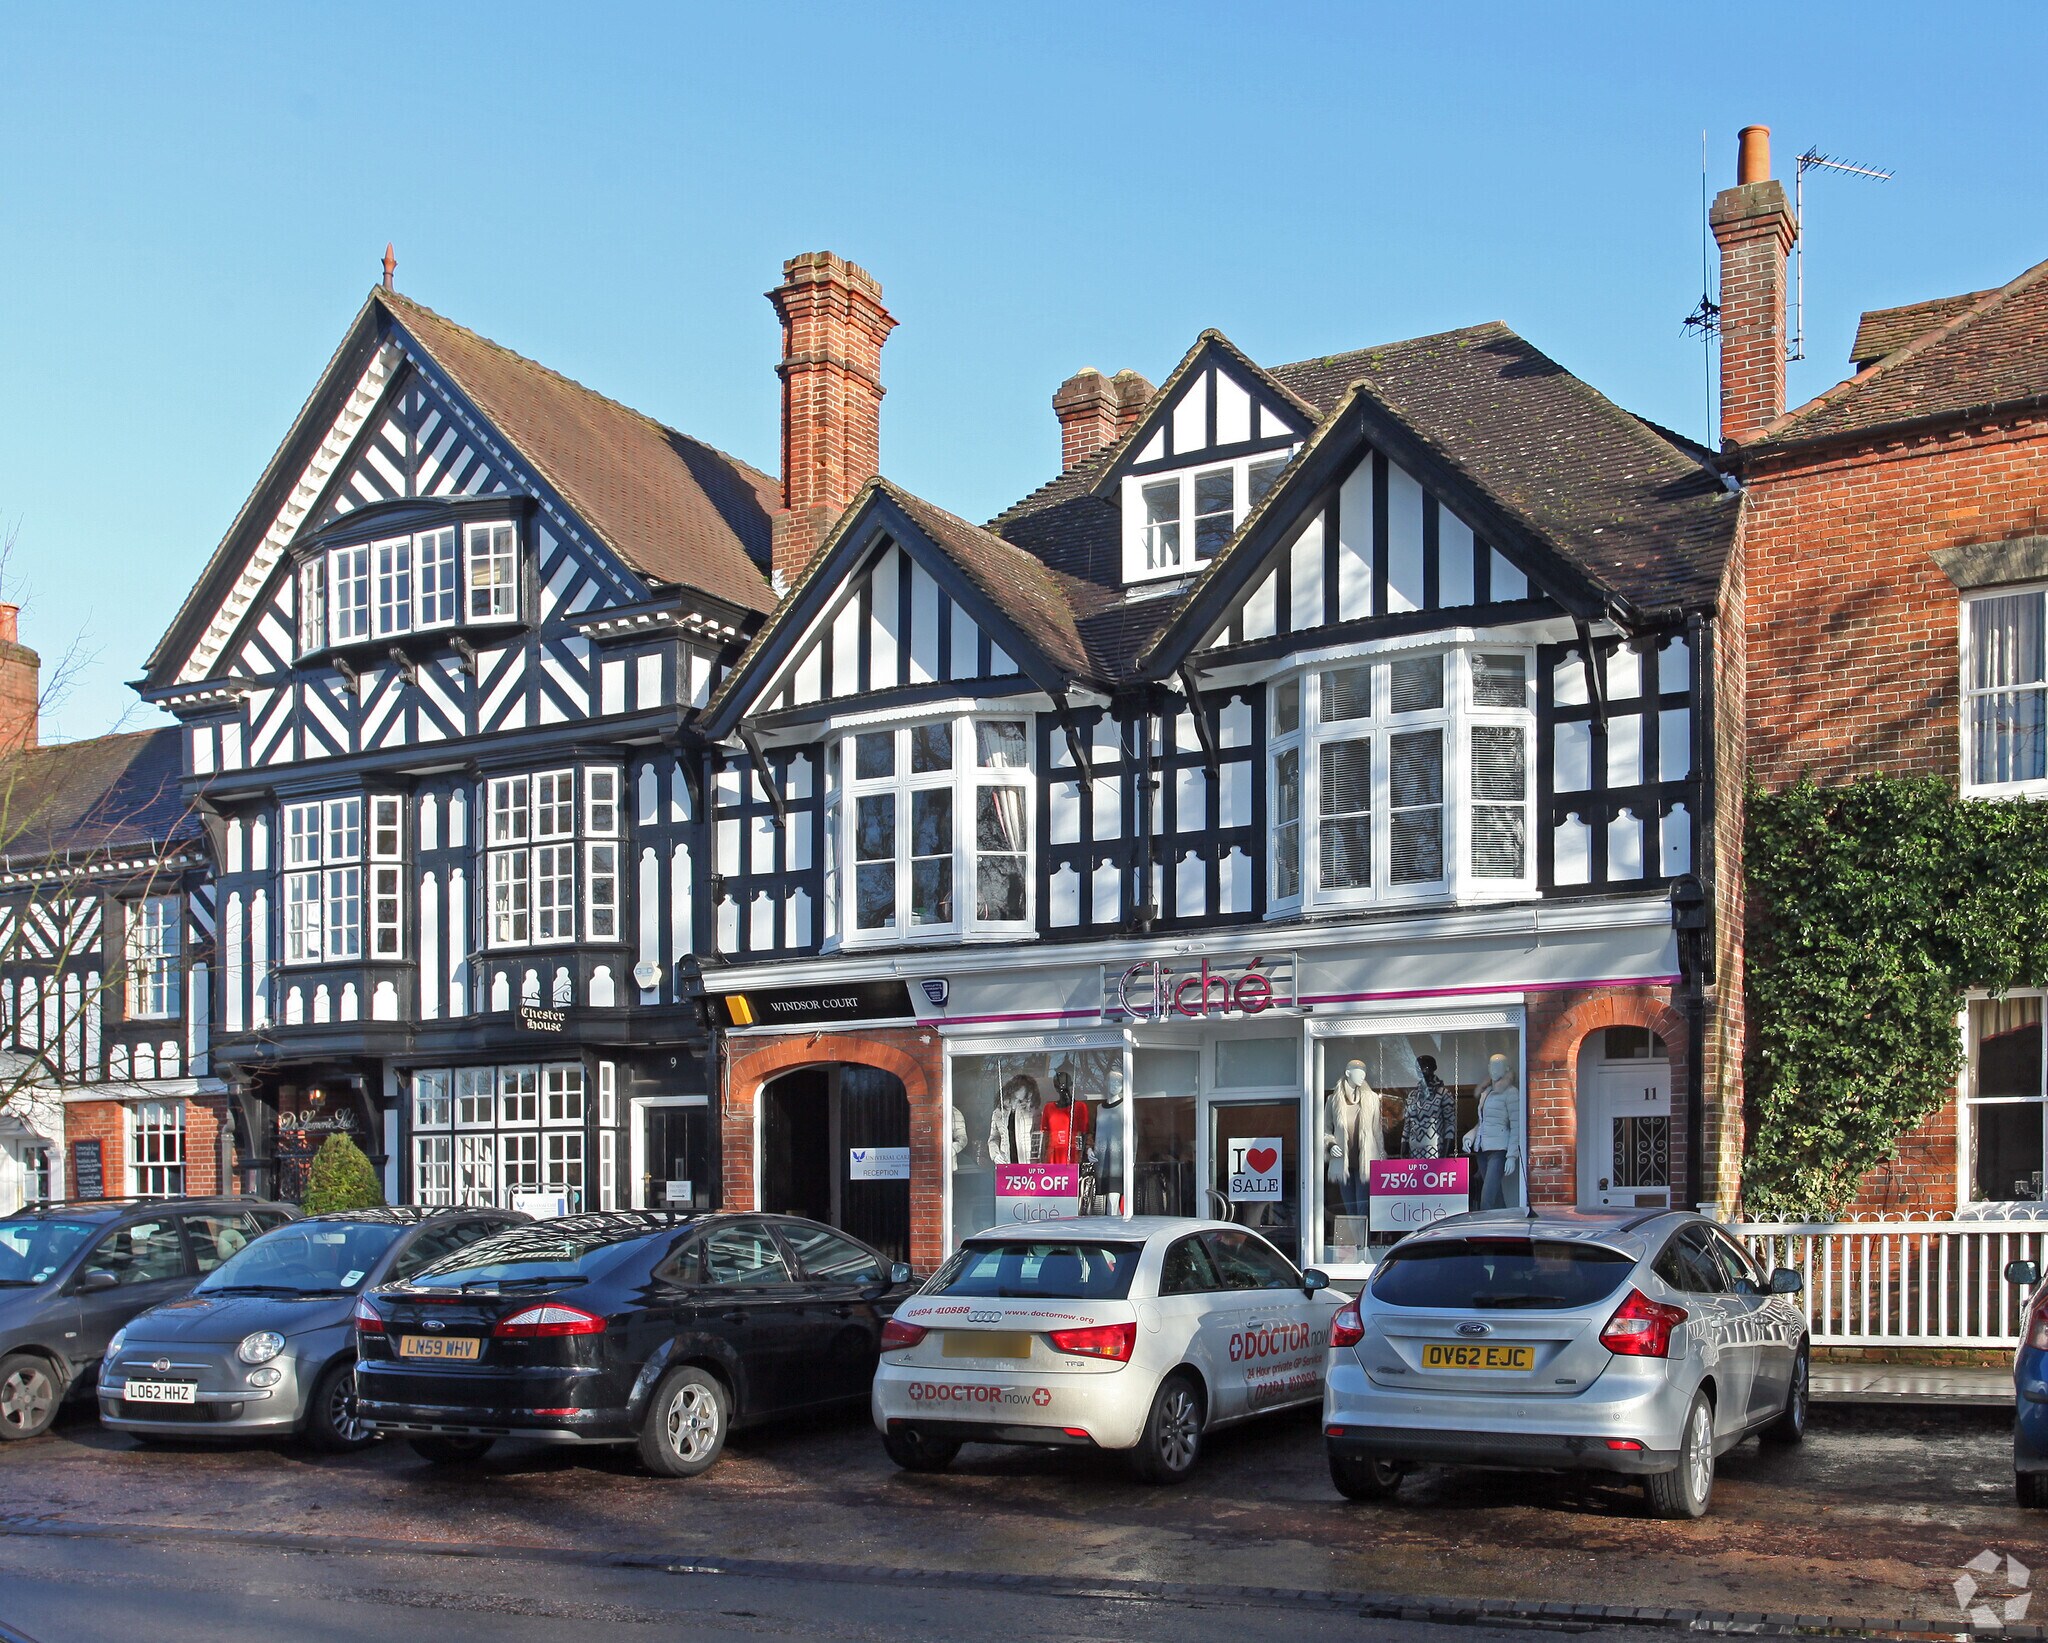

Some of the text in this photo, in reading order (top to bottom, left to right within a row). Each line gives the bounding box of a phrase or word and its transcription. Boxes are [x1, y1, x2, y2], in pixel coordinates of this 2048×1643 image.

[1118, 957, 1274, 1018] Cliché
[771, 998, 858, 1012] WINDSOR COURT
[521, 1007, 565, 1021] Chester
[527, 1019, 562, 1032] House
[671, 1057, 677, 1068] 9
[1644, 1087, 1657, 1100] 11
[1232, 1148, 1246, 1175] I
[863, 1169, 899, 1177] RECEPTION
[1380, 1172, 1456, 1189] 75% OFF
[1005, 1176, 1069, 1191] 75% OFF
[1232, 1179, 1278, 1193] SALE
[1013, 1203, 1060, 1221] Cliché
[1390, 1202, 1447, 1222] Cliché
[907, 1306, 971, 1318] 01494 410888
[1004, 1309, 1095, 1324] www.doctornow.org
[407, 1339, 473, 1357] LN59 WHV
[1244, 1323, 1329, 1360] DOCTOR now
[1430, 1347, 1526, 1366] OV62 EJC
[1247, 1354, 1322, 1379] 24 Hour private GP Service
[130, 1384, 189, 1400] LO62 HHZ
[925, 1384, 1031, 1404] DOCTOR now
